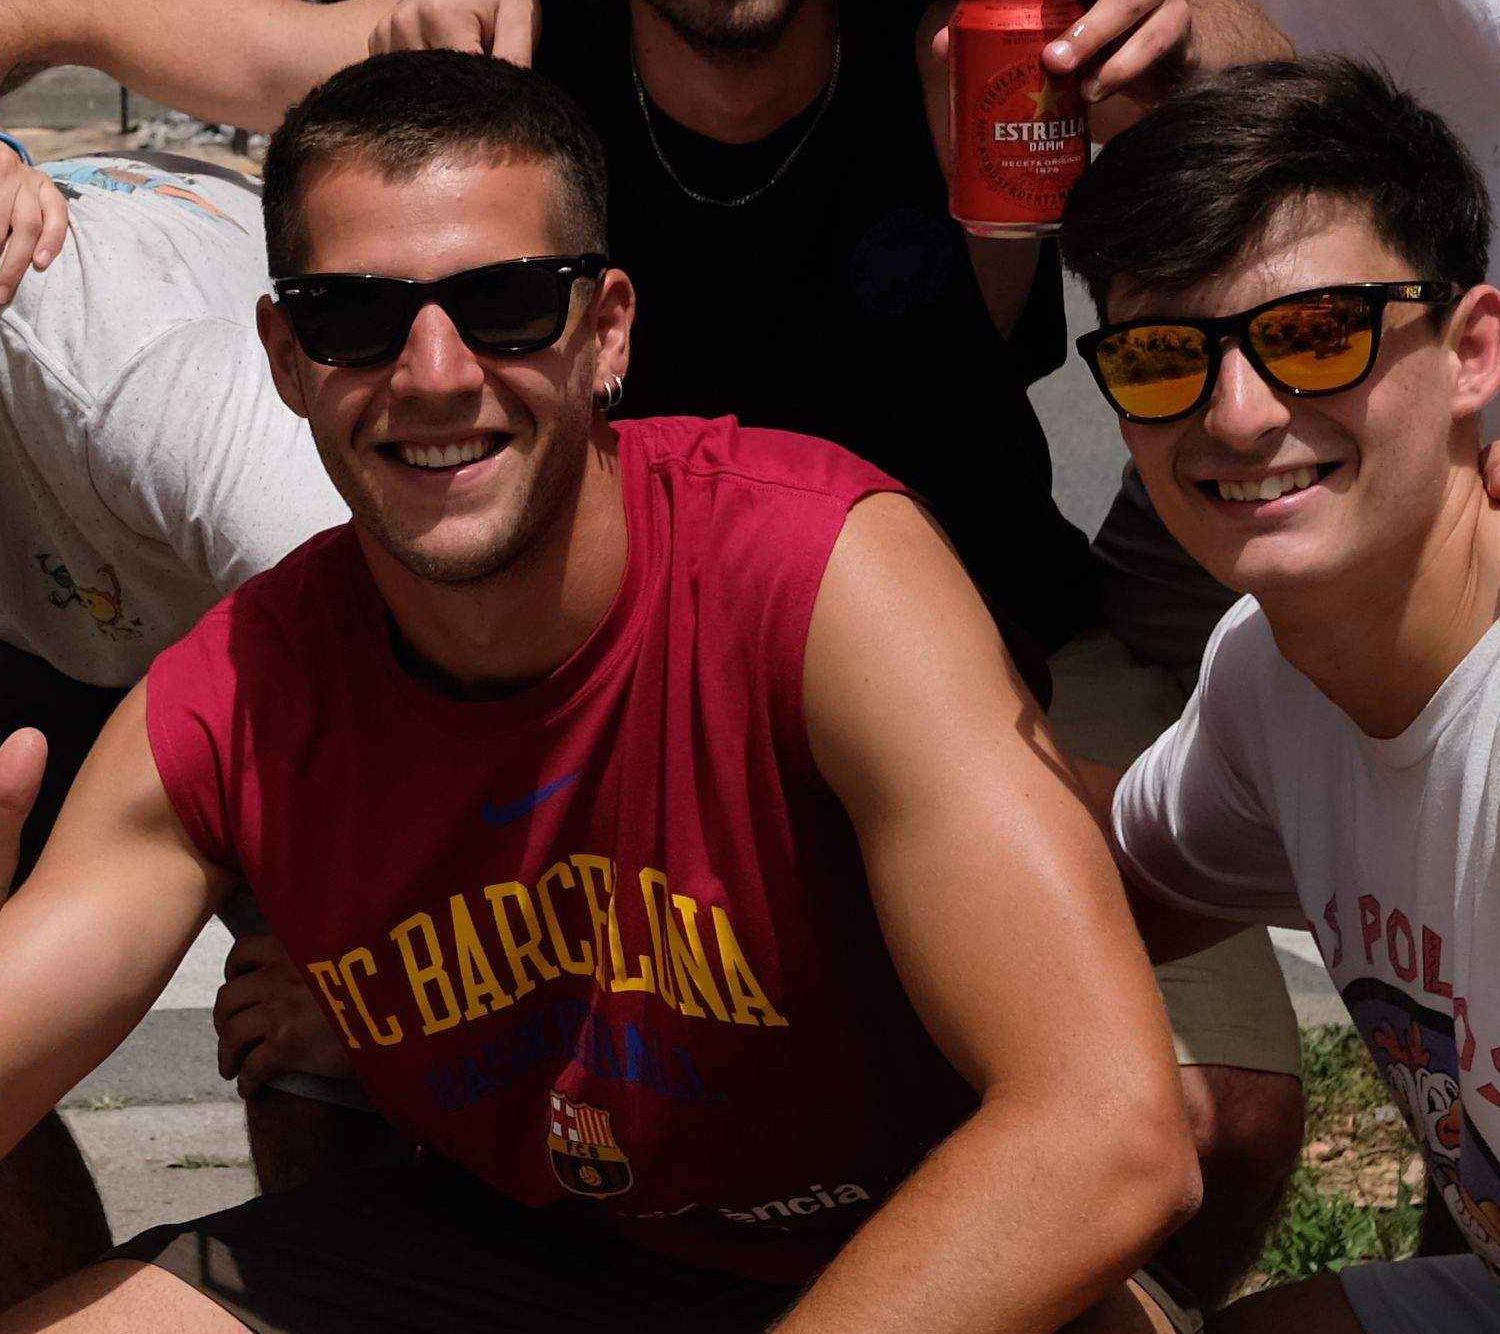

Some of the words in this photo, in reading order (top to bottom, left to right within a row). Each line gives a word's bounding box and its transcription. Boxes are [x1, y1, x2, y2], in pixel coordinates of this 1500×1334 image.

[993, 116, 1085, 142] ESTRELLA
[1029, 140, 1065, 153] DAMM
[306, 946, 403, 1050] FC
[388, 853, 790, 1036] BARCELONA
[566, 1139, 602, 1160] FCB
